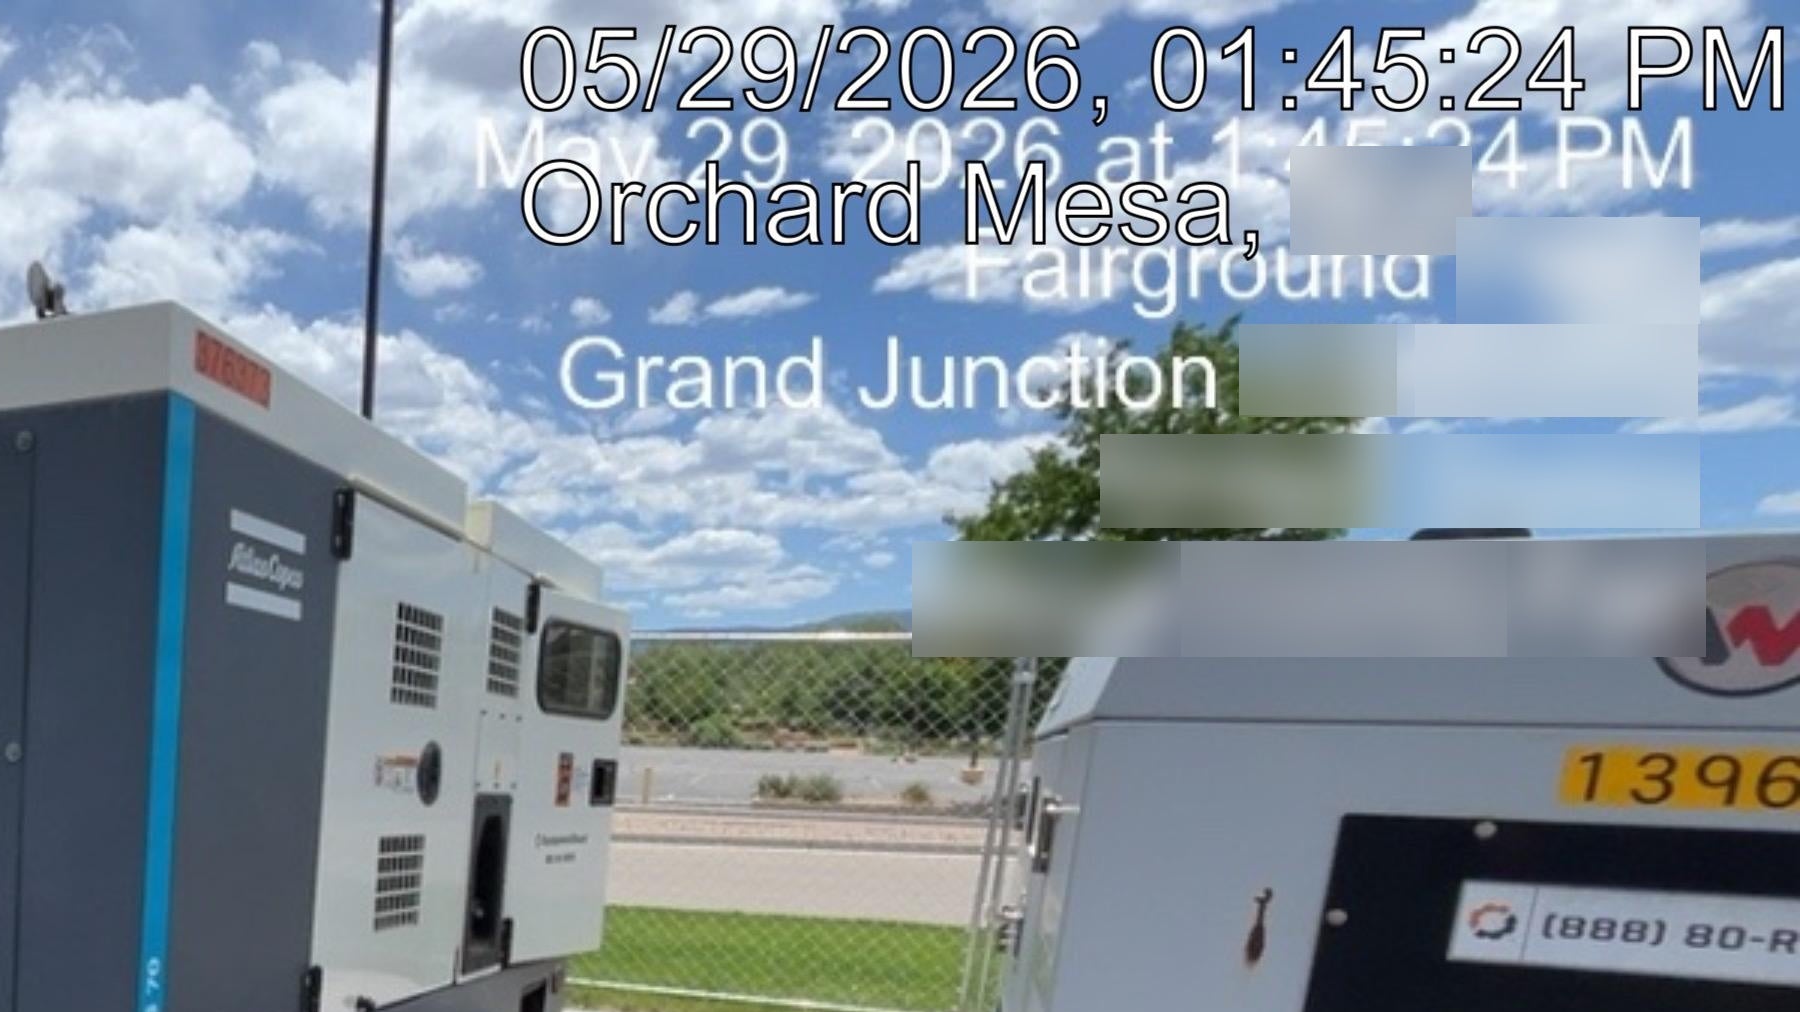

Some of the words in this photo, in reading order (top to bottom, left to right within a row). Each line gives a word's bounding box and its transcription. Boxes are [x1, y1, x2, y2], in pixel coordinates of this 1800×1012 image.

[1578, 752, 1800, 810] 1396
[1542, 913, 1666, 946] (888)
[145, 956, 160, 997] 70
